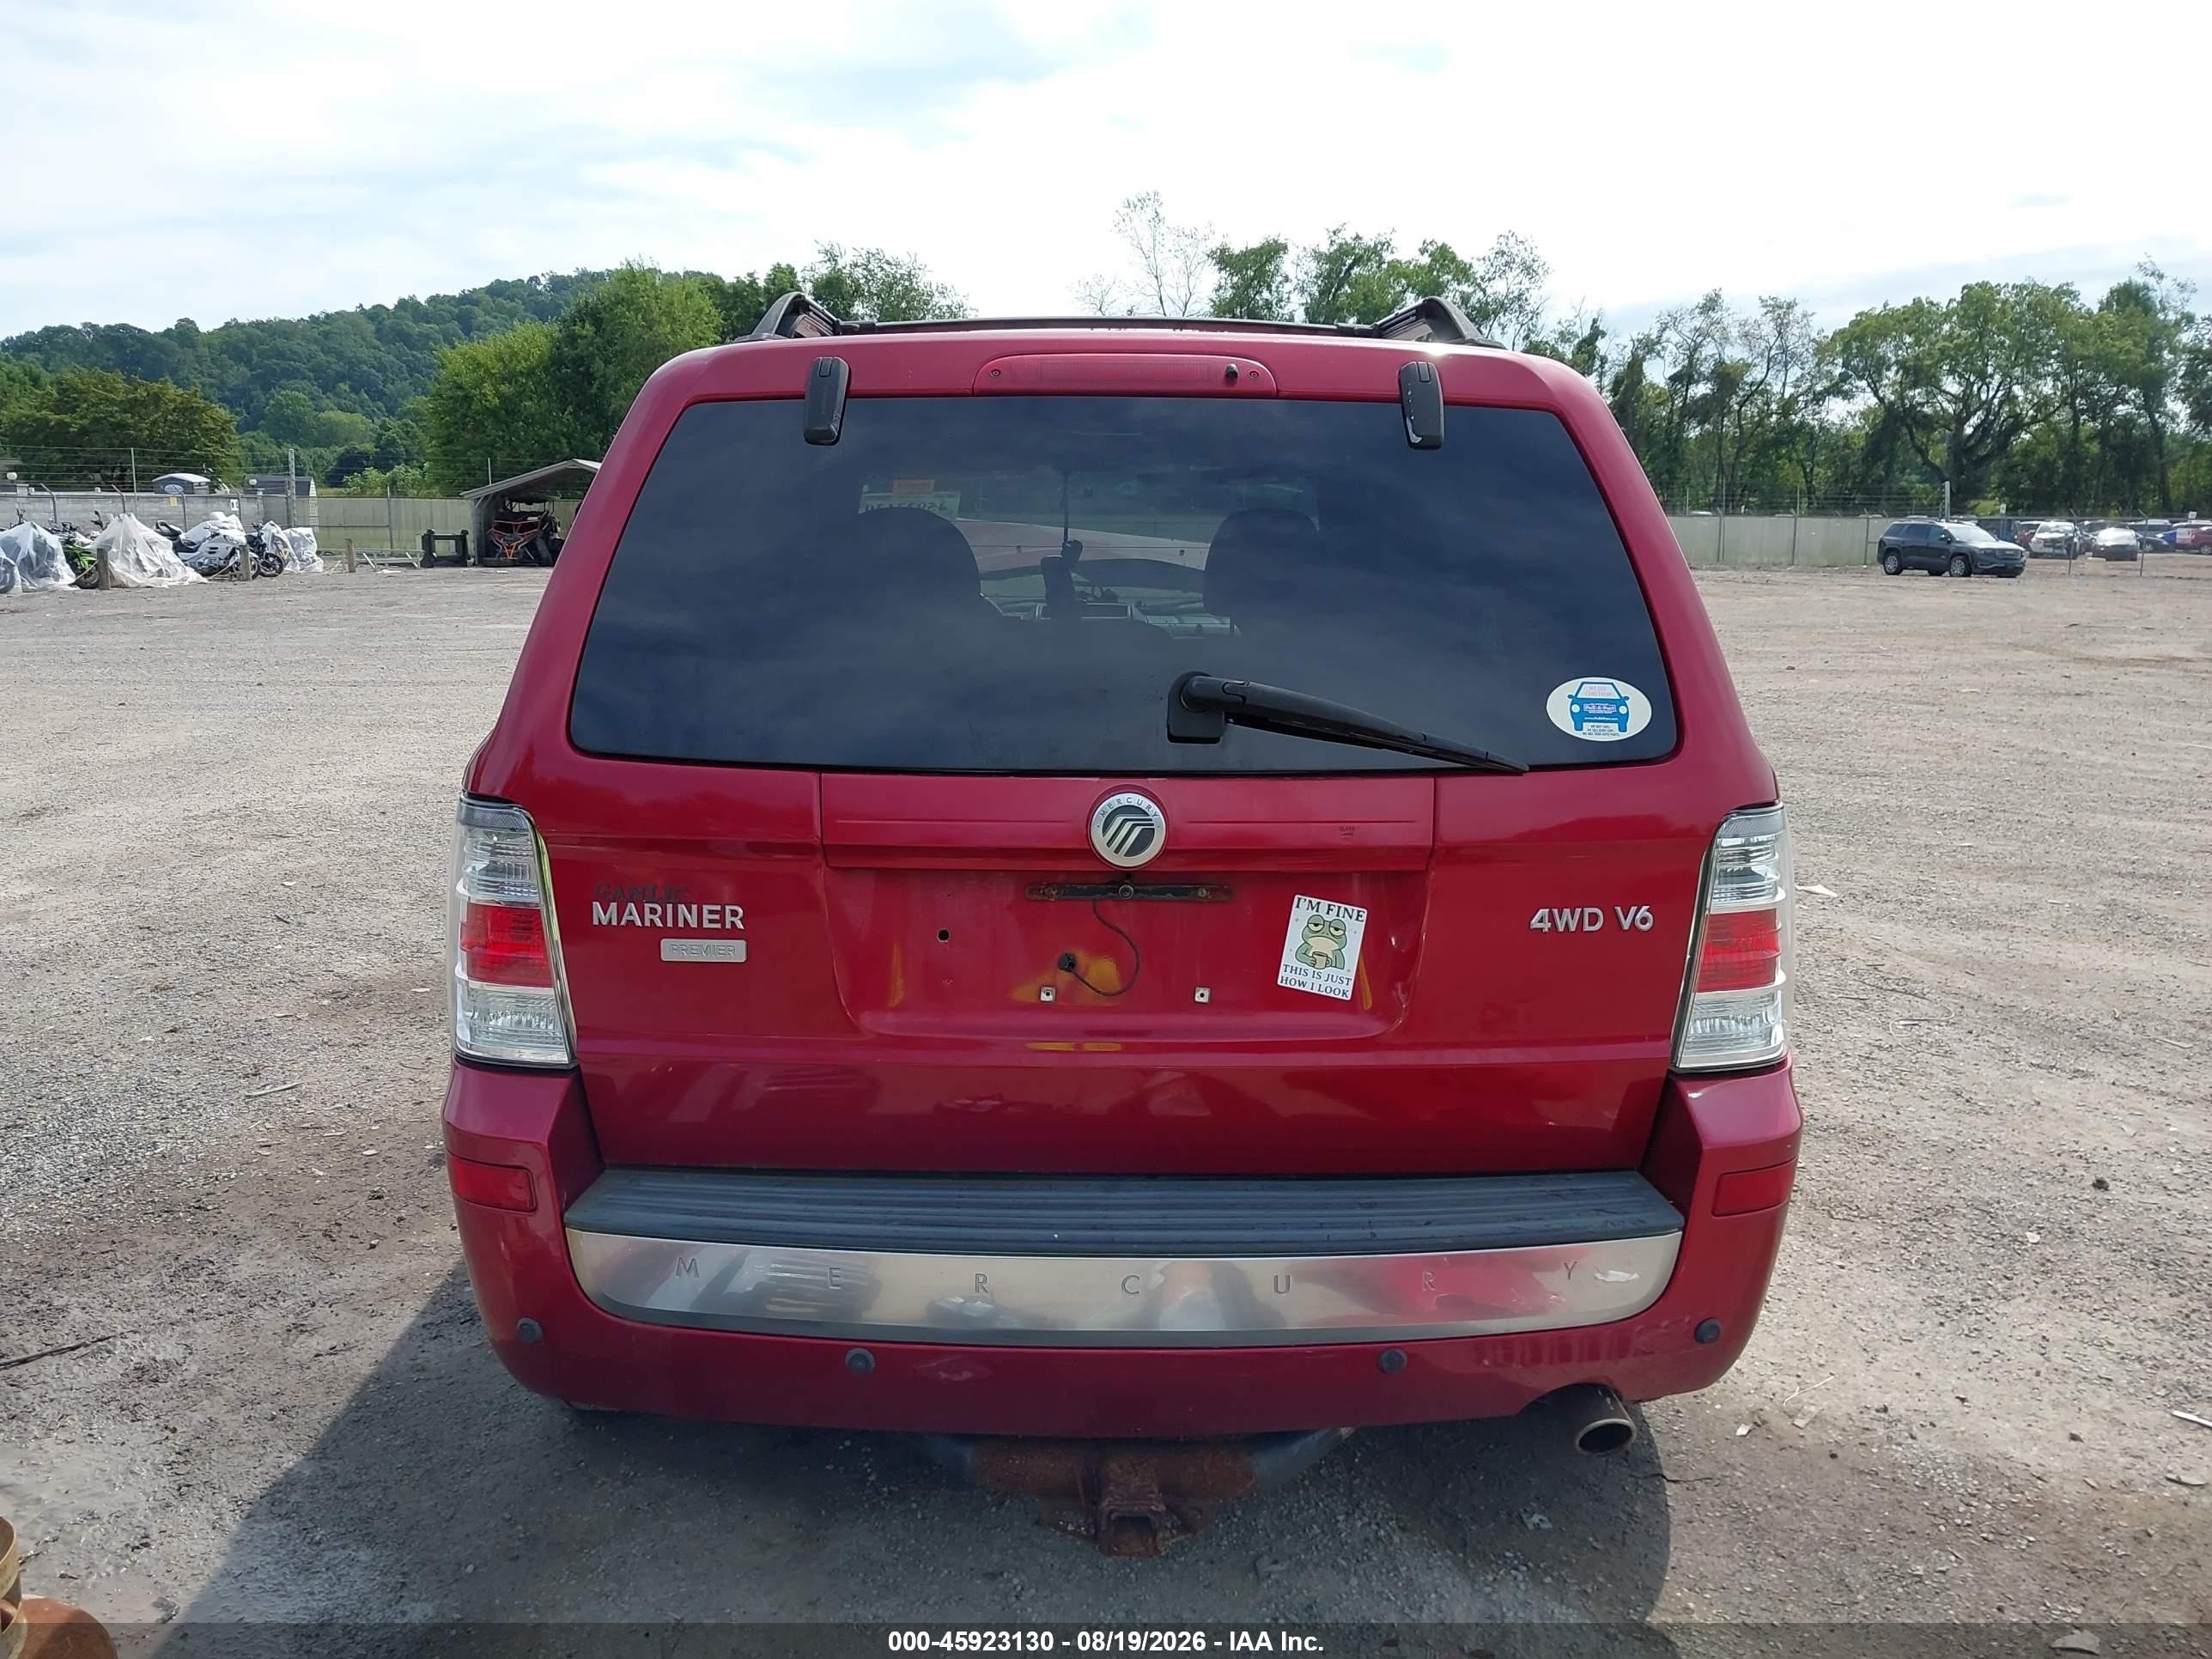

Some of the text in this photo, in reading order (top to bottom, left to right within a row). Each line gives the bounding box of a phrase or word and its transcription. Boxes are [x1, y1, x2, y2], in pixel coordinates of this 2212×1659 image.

[1100, 797, 1160, 818] MERCURY
[592, 901, 745, 930] MARINER
[1295, 896, 1366, 922] I'M FINE
[1529, 905, 1654, 933] 4WD V6
[669, 944, 737, 957] PREMIER
[1279, 975, 1350, 998] HOW I LOOK
[1283, 963, 1352, 986] THIS IS JUST
[675, 1256, 1579, 1296] MERCURY
